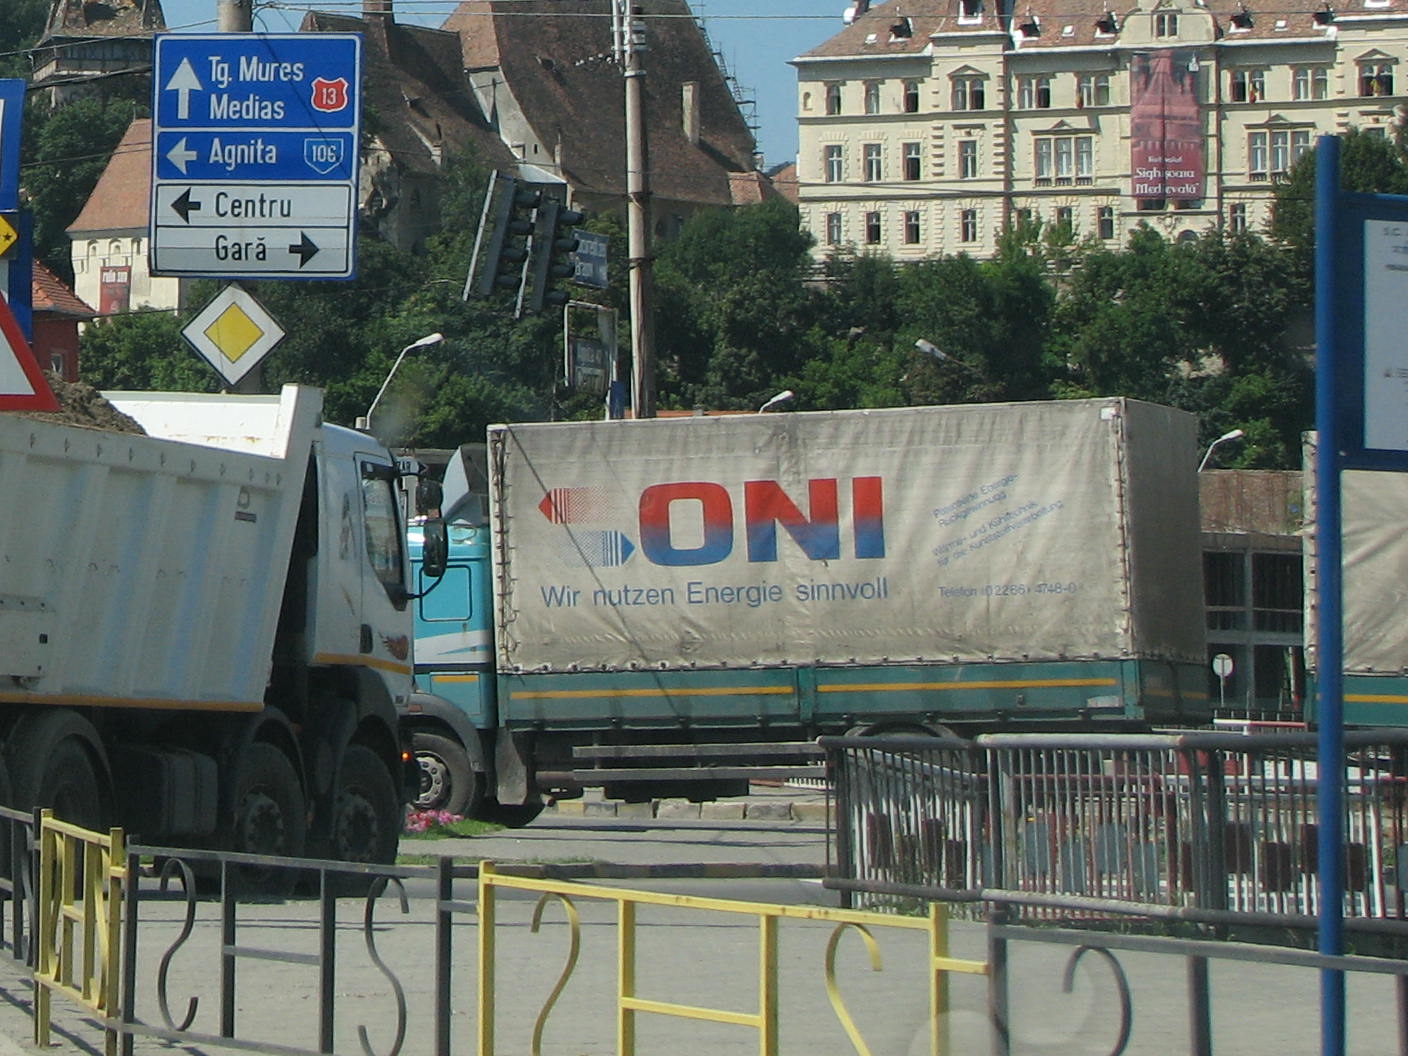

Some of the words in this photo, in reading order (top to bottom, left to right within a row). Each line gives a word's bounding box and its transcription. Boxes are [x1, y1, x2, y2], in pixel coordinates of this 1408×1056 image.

[208, 56, 232, 89] Tg.
[239, 55, 304, 82] Mures
[209, 93, 285, 120] Medias
[321, 87, 338, 105] 13
[208, 137, 277, 171] Agnita
[311, 144, 337, 163] 106
[215, 191, 291, 218] Centru
[215, 235, 267, 261] Gară
[638, 476, 886, 567] ONI
[541, 585, 579, 608] Wir
[593, 584, 675, 606] nutzen
[687, 581, 783, 610] Energie
[796, 577, 888, 603] sinnvoll
